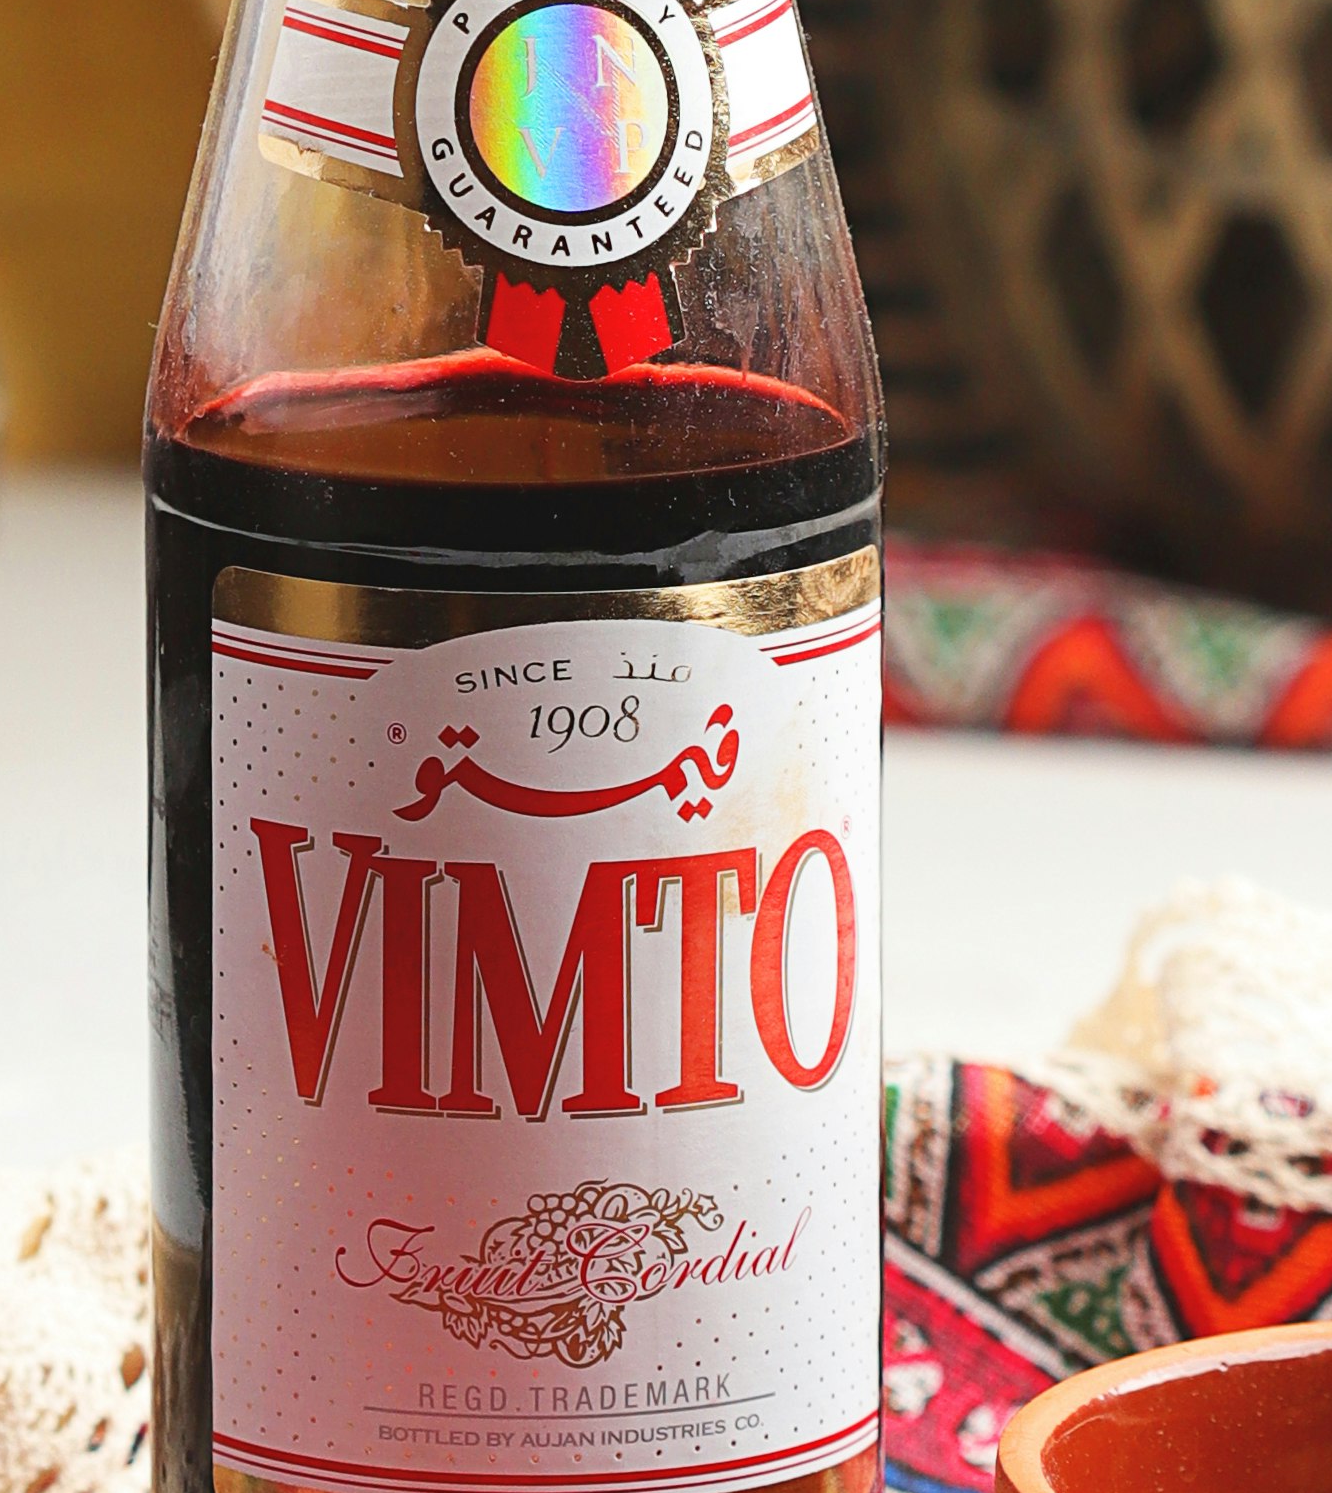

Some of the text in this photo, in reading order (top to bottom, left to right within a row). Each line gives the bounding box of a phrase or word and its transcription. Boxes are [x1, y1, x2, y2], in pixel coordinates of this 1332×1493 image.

[431, 129, 704, 257] GUARANTEED
[454, 659, 572, 694] SINCE
[612, 651, 692, 683] منذ
[529, 695, 641, 754] 1908
[249, 817, 859, 1122] VIMTO
[335, 1205, 813, 1305] Fruit Cordial
[378, 1414, 765, 1448] BOTTLED BY AUJAN INDUSTRIES CO.
